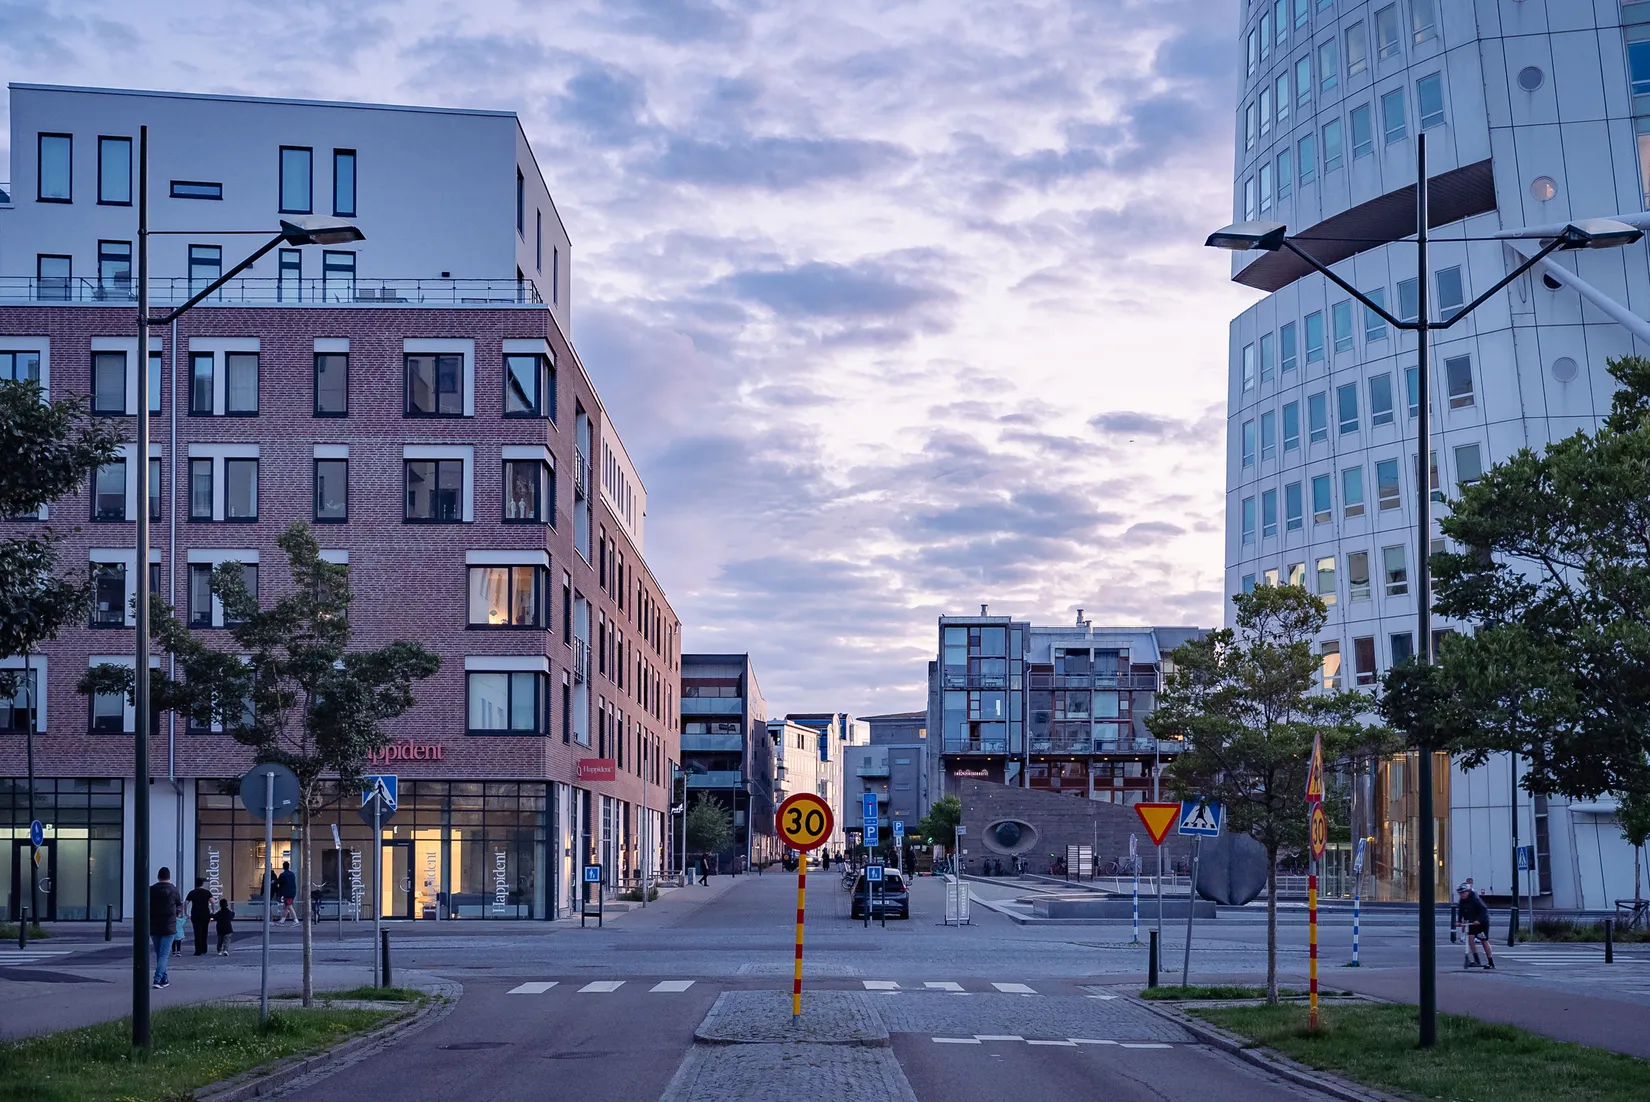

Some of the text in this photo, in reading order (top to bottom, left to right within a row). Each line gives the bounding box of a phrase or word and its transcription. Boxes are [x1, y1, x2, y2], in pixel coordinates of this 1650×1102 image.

[785, 807, 825, 837] 30
[867, 826, 876, 838] P
[895, 822, 902, 831] P
[1313, 818, 1324, 845] 30
[492, 851, 510, 913] Happident
